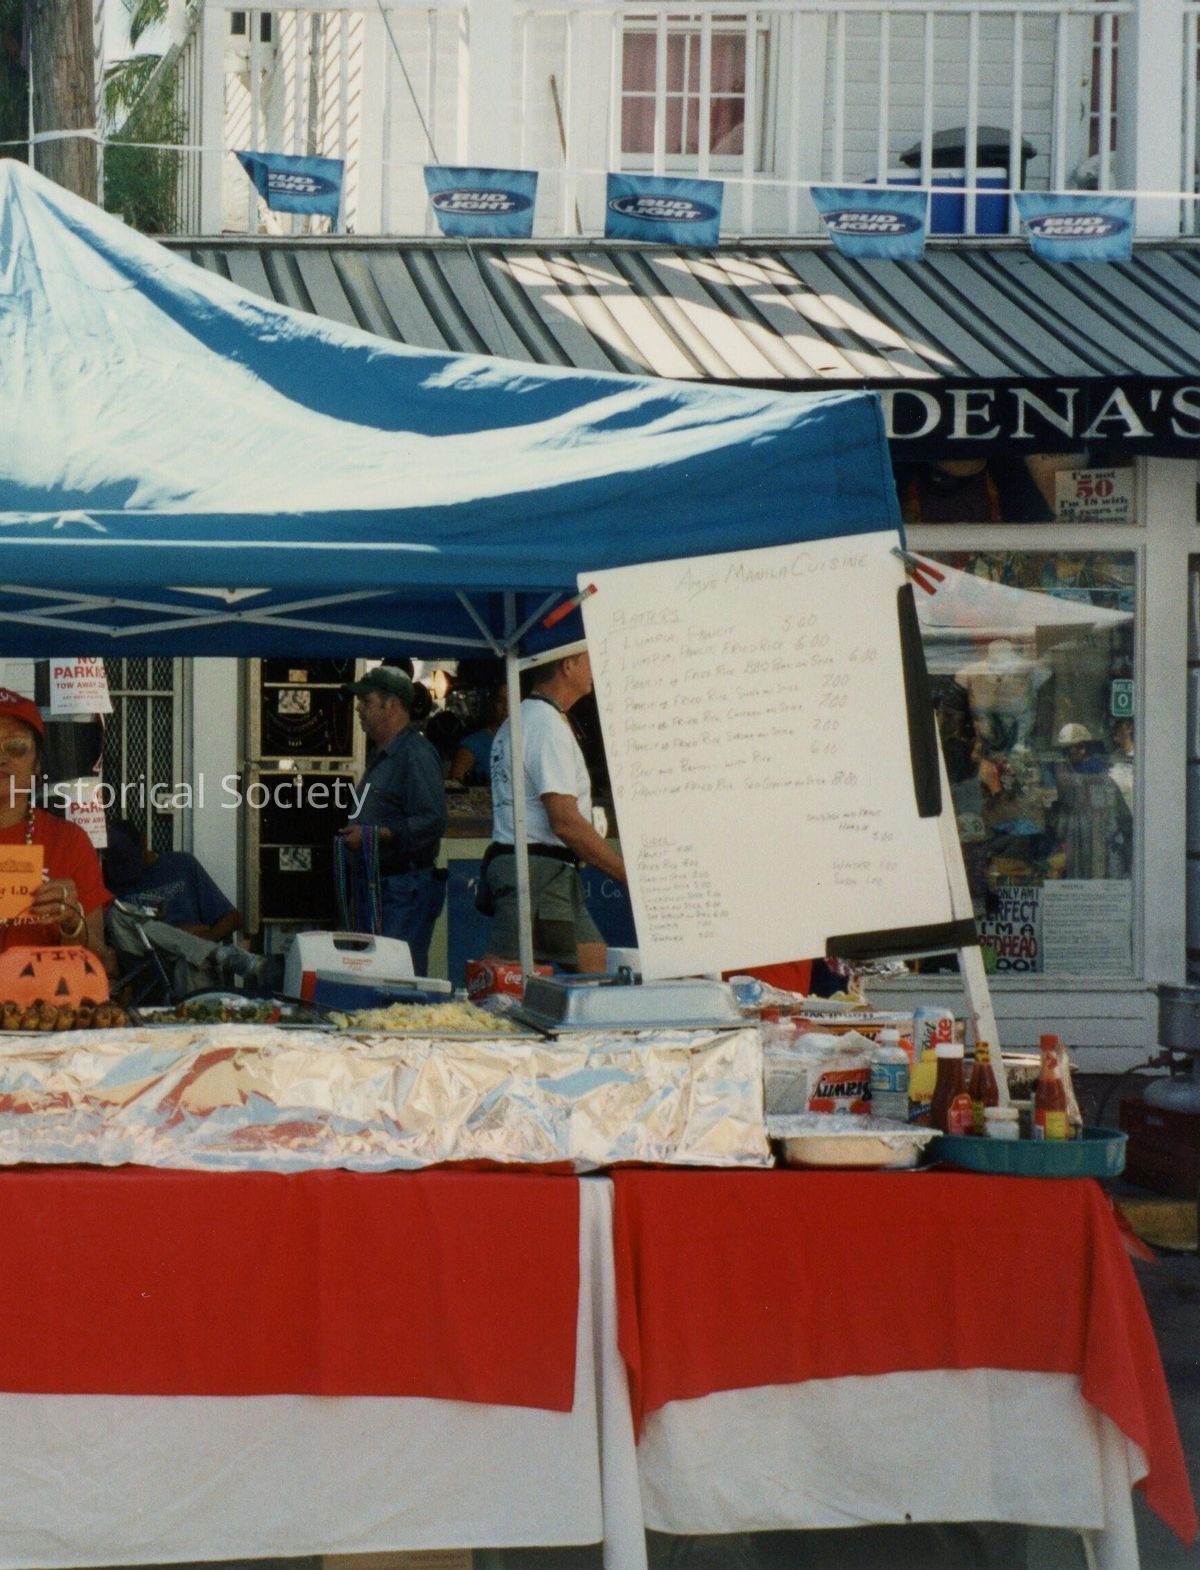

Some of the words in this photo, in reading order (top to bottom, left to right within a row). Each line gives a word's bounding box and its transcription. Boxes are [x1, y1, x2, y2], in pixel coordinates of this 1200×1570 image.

[450, 191, 508, 202] BUD
[438, 200, 516, 211] LIGHT
[637, 198, 693, 211] BUD
[623, 205, 701, 220] LIGHT
[848, 213, 899, 225] BUD
[1043, 216, 1104, 227] BUD
[827, 221, 907, 234] LIGHT
[1033, 224, 1112, 237] LIGHT
[1072, 472, 1092, 480] I'm
[1096, 471, 1116, 479] not
[1076, 479, 1114, 498] 50
[1061, 500, 1079, 508] I'm
[1102, 496, 1128, 505] with
[1118, 693, 1129, 708] 0
[981, 922, 1014, 936] I'M
[1020, 923, 1034, 936] A
[31, 951, 89, 962] TIPS
